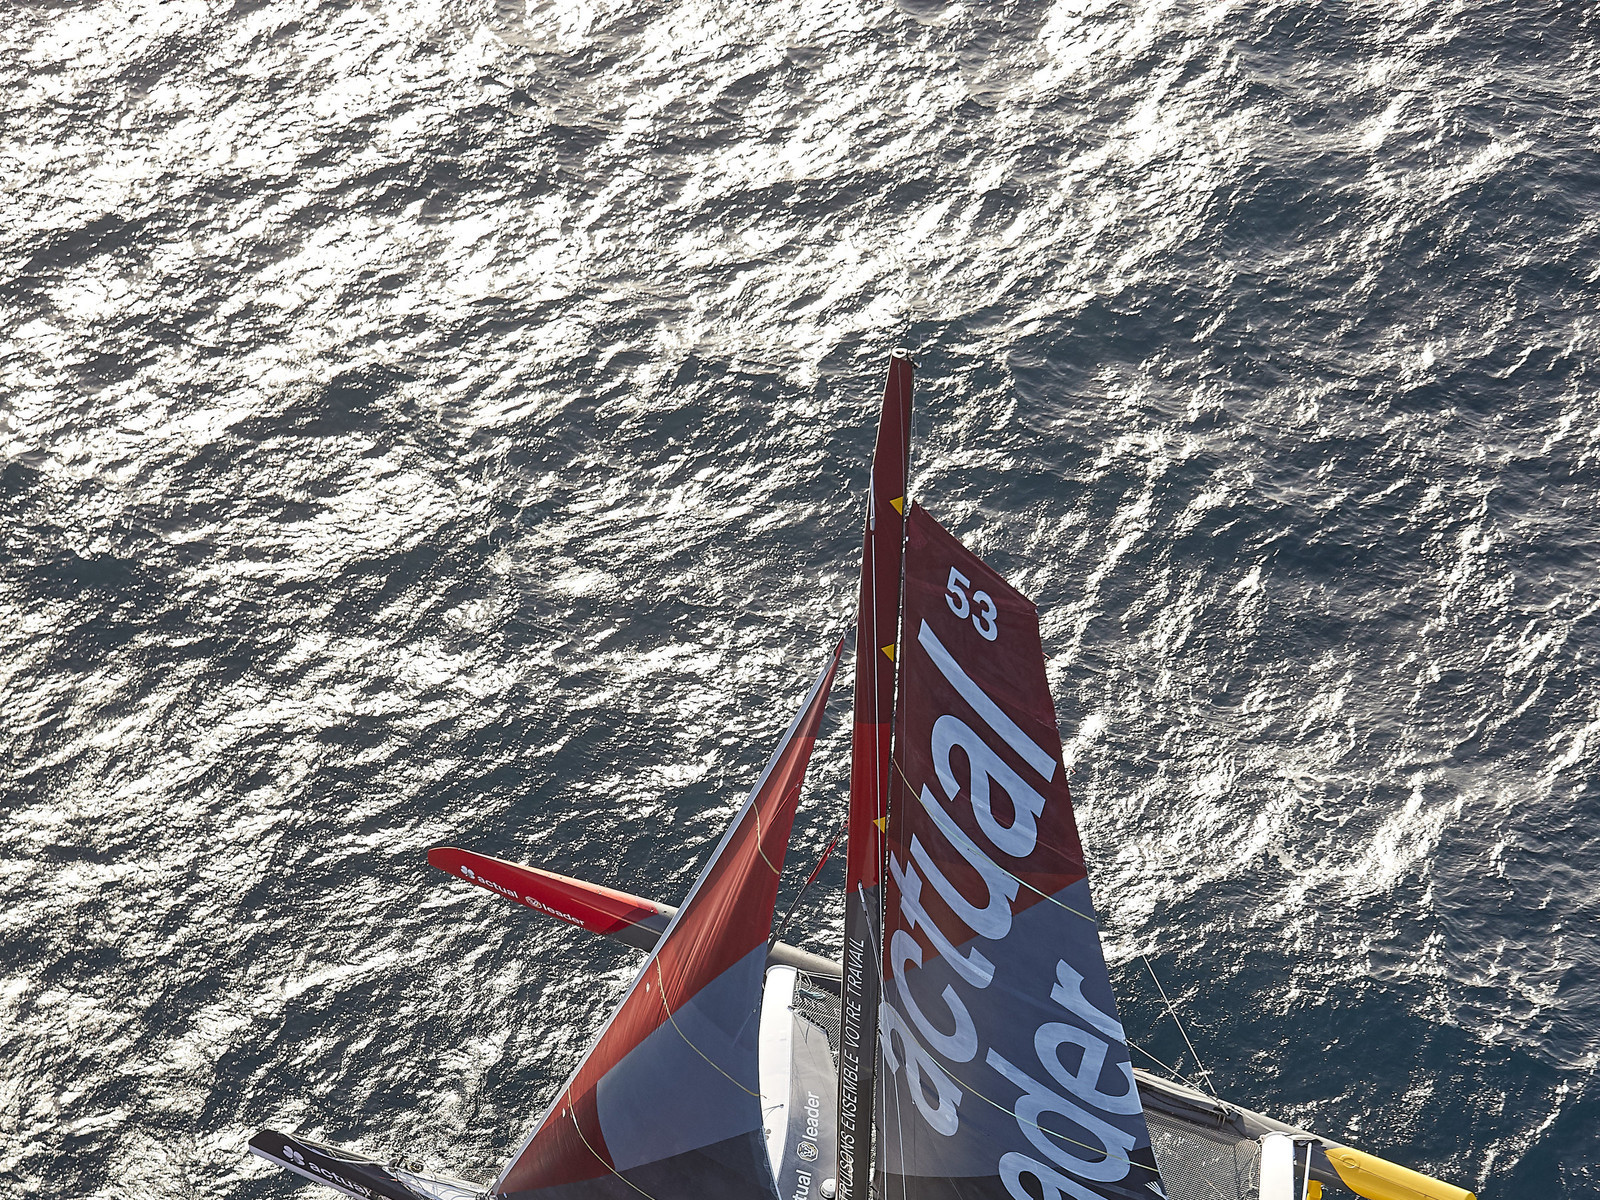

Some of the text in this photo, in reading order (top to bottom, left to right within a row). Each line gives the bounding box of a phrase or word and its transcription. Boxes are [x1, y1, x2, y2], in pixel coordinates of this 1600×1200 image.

[944, 567, 997, 642] 53
[477, 875, 585, 926] actual leader
[879, 617, 1057, 1136] actual
[847, 937, 865, 997] TRAVAIL
[843, 998, 863, 1048] VOTRE
[802, 1091, 820, 1141] leader
[841, 1049, 860, 1132] ENSEMBLE
